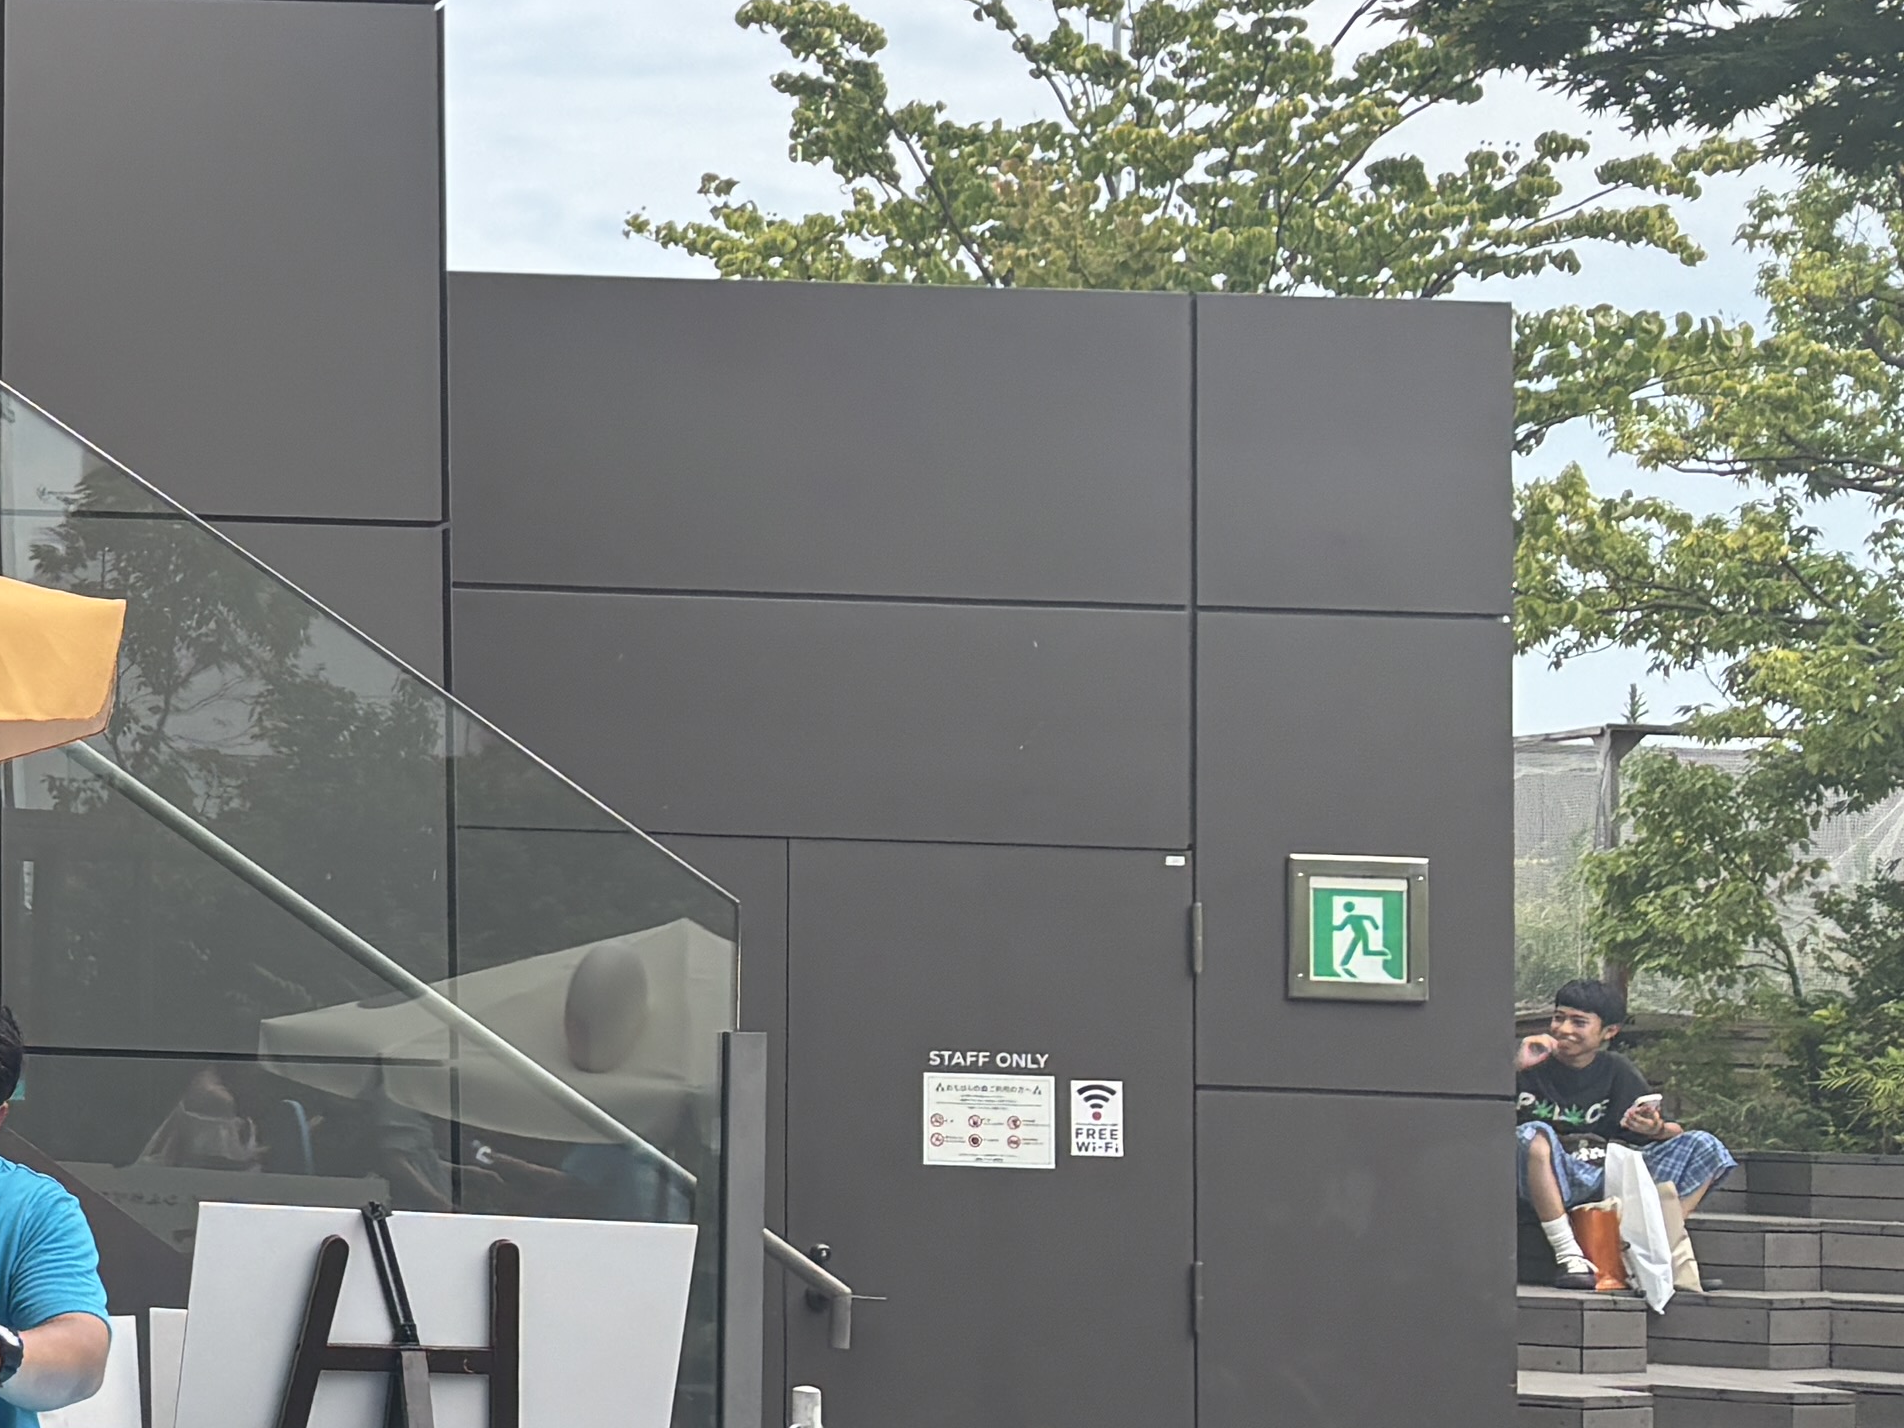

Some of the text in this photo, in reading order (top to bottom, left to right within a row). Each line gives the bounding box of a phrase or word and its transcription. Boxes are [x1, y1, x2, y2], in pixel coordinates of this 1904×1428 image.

[929, 1050, 1049, 1069] STAFF ONLY
[1075, 1127, 1119, 1140] FREE
[1076, 1141, 1119, 1153] Wi-Fi
